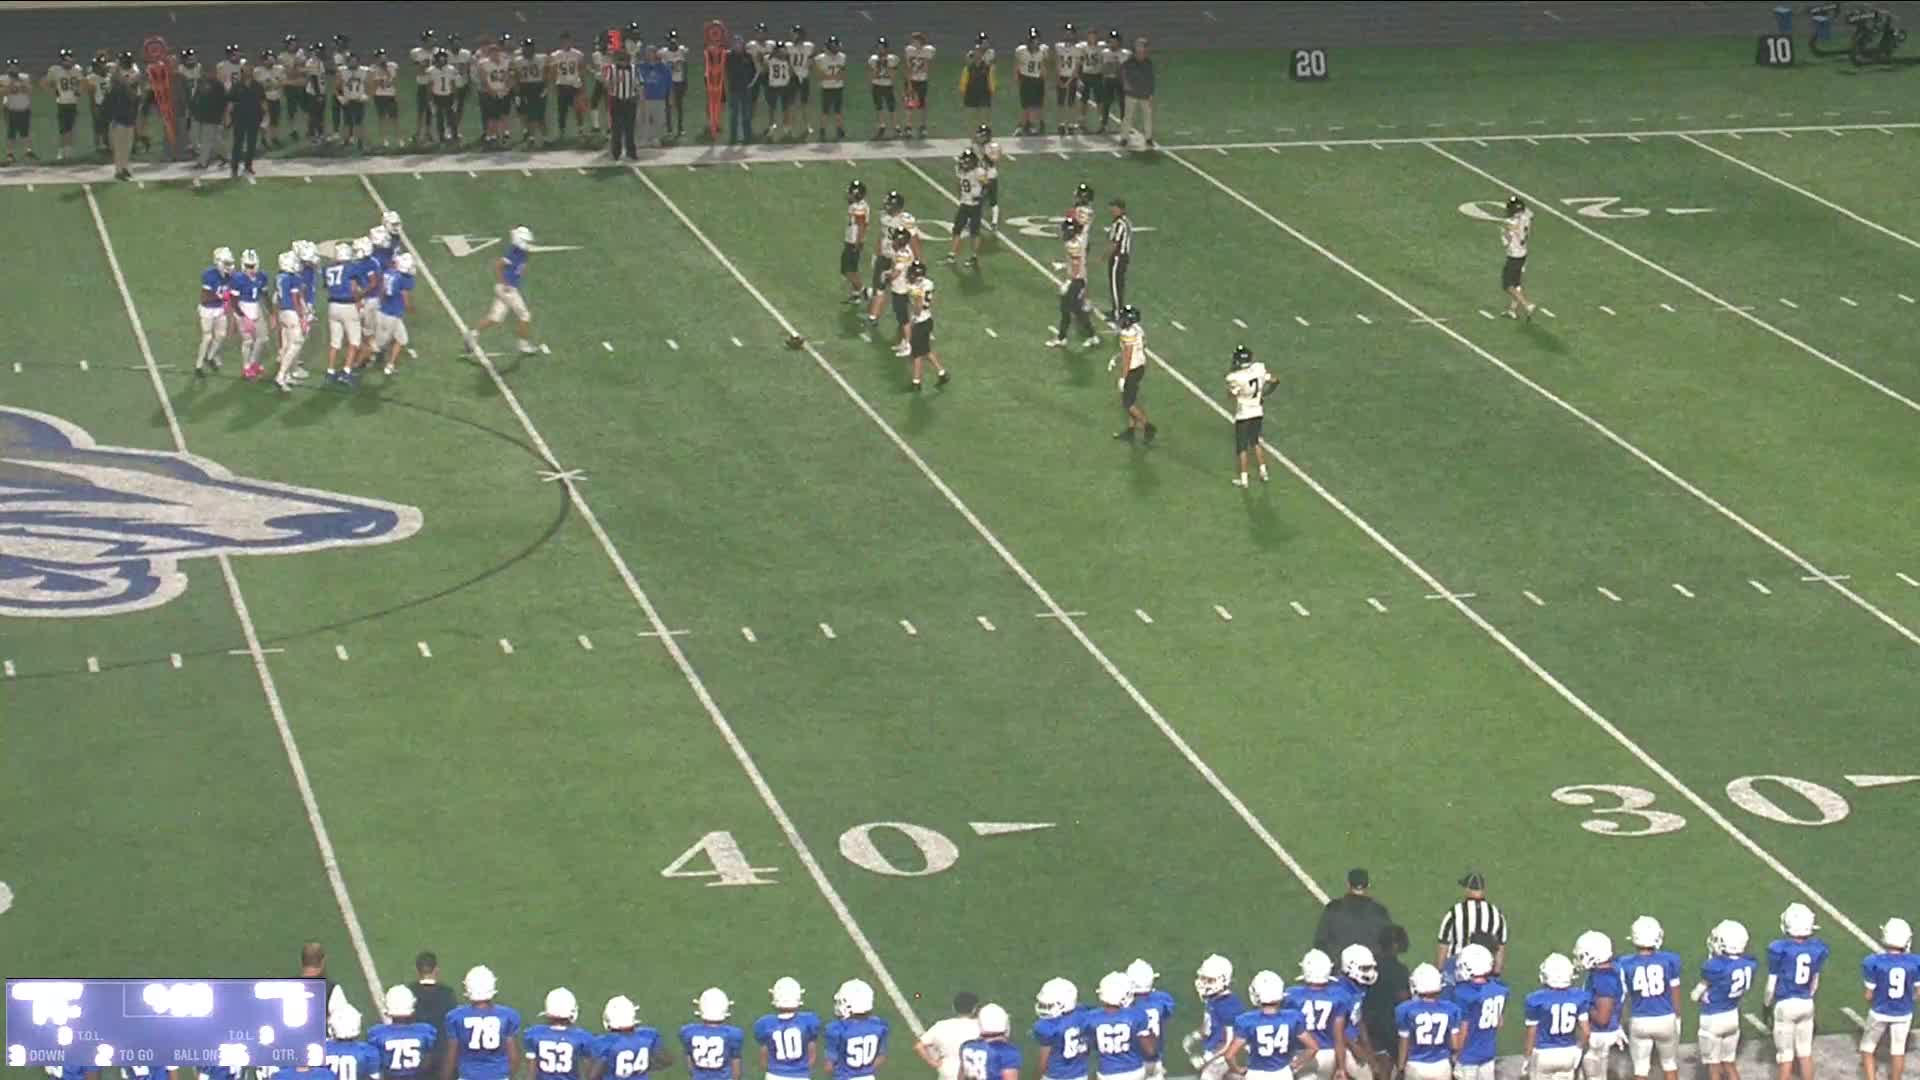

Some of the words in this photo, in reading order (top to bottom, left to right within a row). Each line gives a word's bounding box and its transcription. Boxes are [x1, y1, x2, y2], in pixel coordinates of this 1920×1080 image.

[1296, 50, 1326, 76] 20
[1767, 37, 1791, 63] 10
[326, 265, 345, 287] 57
[1249, 377, 1259, 398] 7
[1632, 964, 1665, 998] 48
[1728, 968, 1753, 998] 21
[1795, 953, 1811, 985] 6
[1888, 967, 1906, 999] 9
[1302, 1000, 1333, 1030] 47
[1415, 1012, 1449, 1045] 27
[1550, 1002, 1577, 1035] 16
[463, 1016, 501, 1050] 78
[772, 1027, 803, 1060] 10
[1096, 1023, 1131, 1054] 62
[1256, 1024, 1290, 1057] 54
[385, 1038, 421, 1070] 75
[538, 1041, 574, 1073] 53
[616, 1047, 649, 1078] 64
[691, 1035, 724, 1070] 22
[846, 1034, 879, 1068] 50
